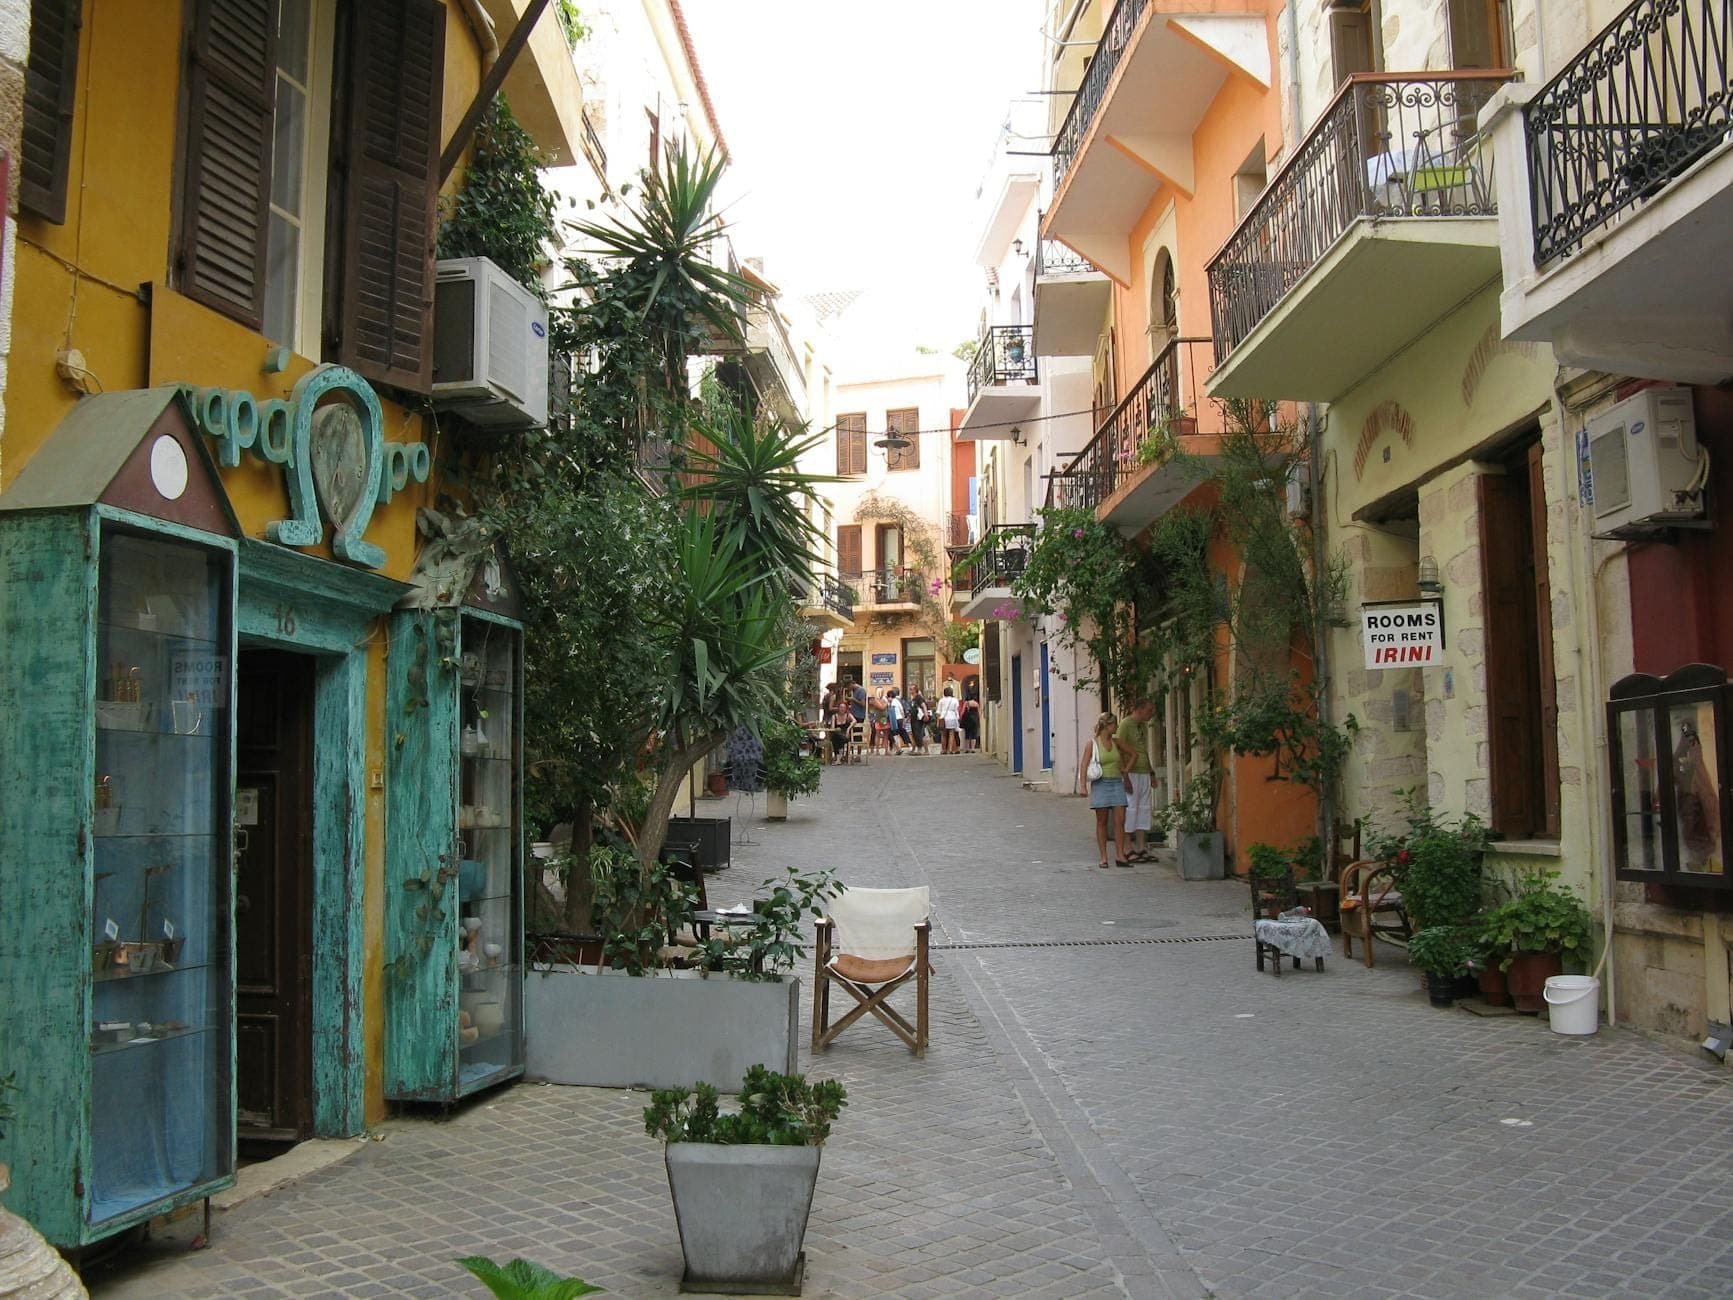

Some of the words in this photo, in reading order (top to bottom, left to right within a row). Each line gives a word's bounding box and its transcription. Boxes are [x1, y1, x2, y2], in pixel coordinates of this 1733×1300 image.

[275, 606, 297, 637] 16
[1367, 613, 1436, 629] ROOMS
[1371, 633, 1395, 643] FOR
[1401, 631, 1434, 642] RENT
[1375, 645, 1432, 664] IRINI
